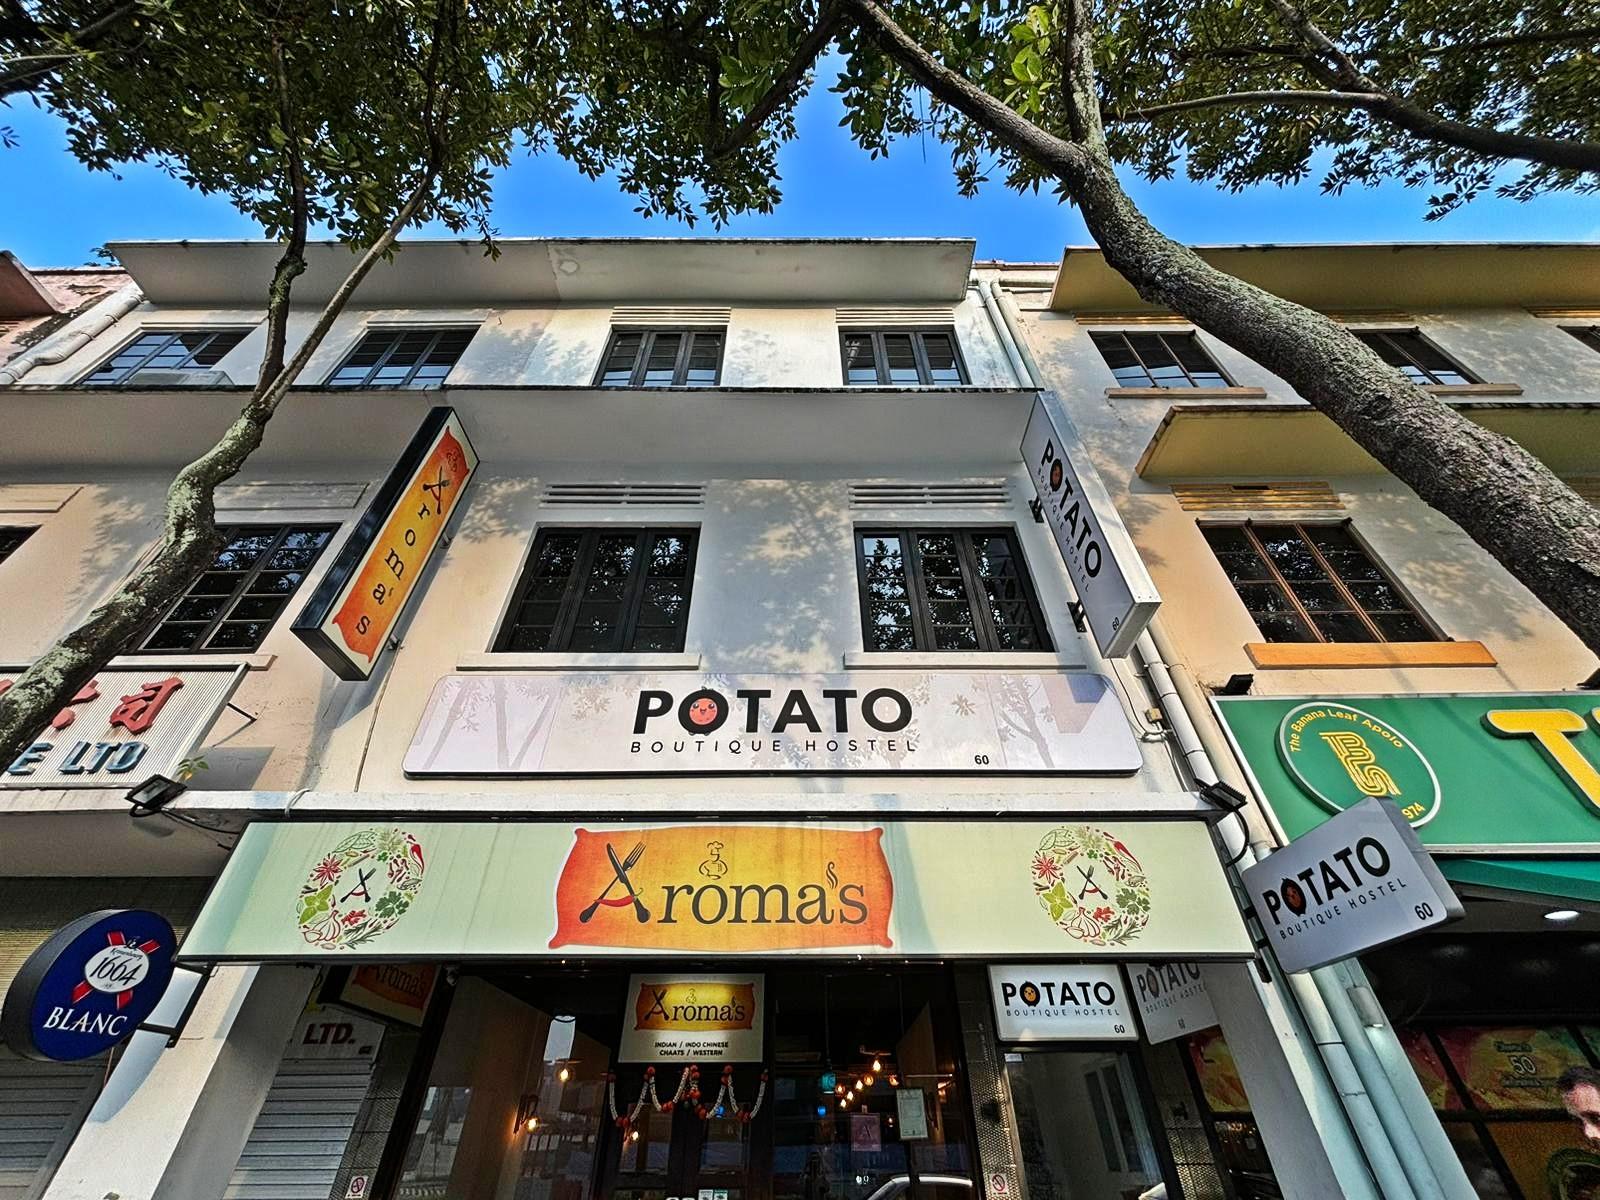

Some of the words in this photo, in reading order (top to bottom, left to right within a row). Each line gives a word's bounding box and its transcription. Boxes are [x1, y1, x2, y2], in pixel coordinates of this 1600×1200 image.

[1041, 438, 1102, 578] POTATO
[1037, 467, 1065, 531] BOUTIQUE
[1065, 536, 1089, 593] HOSTEL
[1111, 616, 1120, 632] 60
[632, 687, 912, 735] POTATO
[1291, 709, 1326, 732] Banana
[1327, 709, 1358, 722] Leaf
[630, 740, 782, 754] BOUTIQUE
[805, 739, 916, 752] HOSTEL
[1289, 733, 1301, 753] The
[1362, 719, 1404, 749] Apolo
[8, 742, 52, 775] E
[58, 741, 149, 774] LTD
[974, 754, 990, 765] 60
[1484, 708, 1600, 819] T
[1401, 802, 1426, 819] 974
[579, 841, 868, 924] Aroma's
[1262, 836, 1391, 925] POTATO
[1279, 906, 1341, 940] BOUTIQUE
[1349, 877, 1407, 909] HOSTEL
[1414, 902, 1434, 920] 60
[89, 955, 143, 986] 1664
[644, 989, 745, 1022] Aroma's
[1001, 981, 1116, 1007] POTATO
[43, 1007, 128, 1036] BLANC
[1006, 1009, 1067, 1018] BOUTIQUE
[303, 1022, 355, 1045] LTD.
[1114, 1024, 1125, 1034] 60
